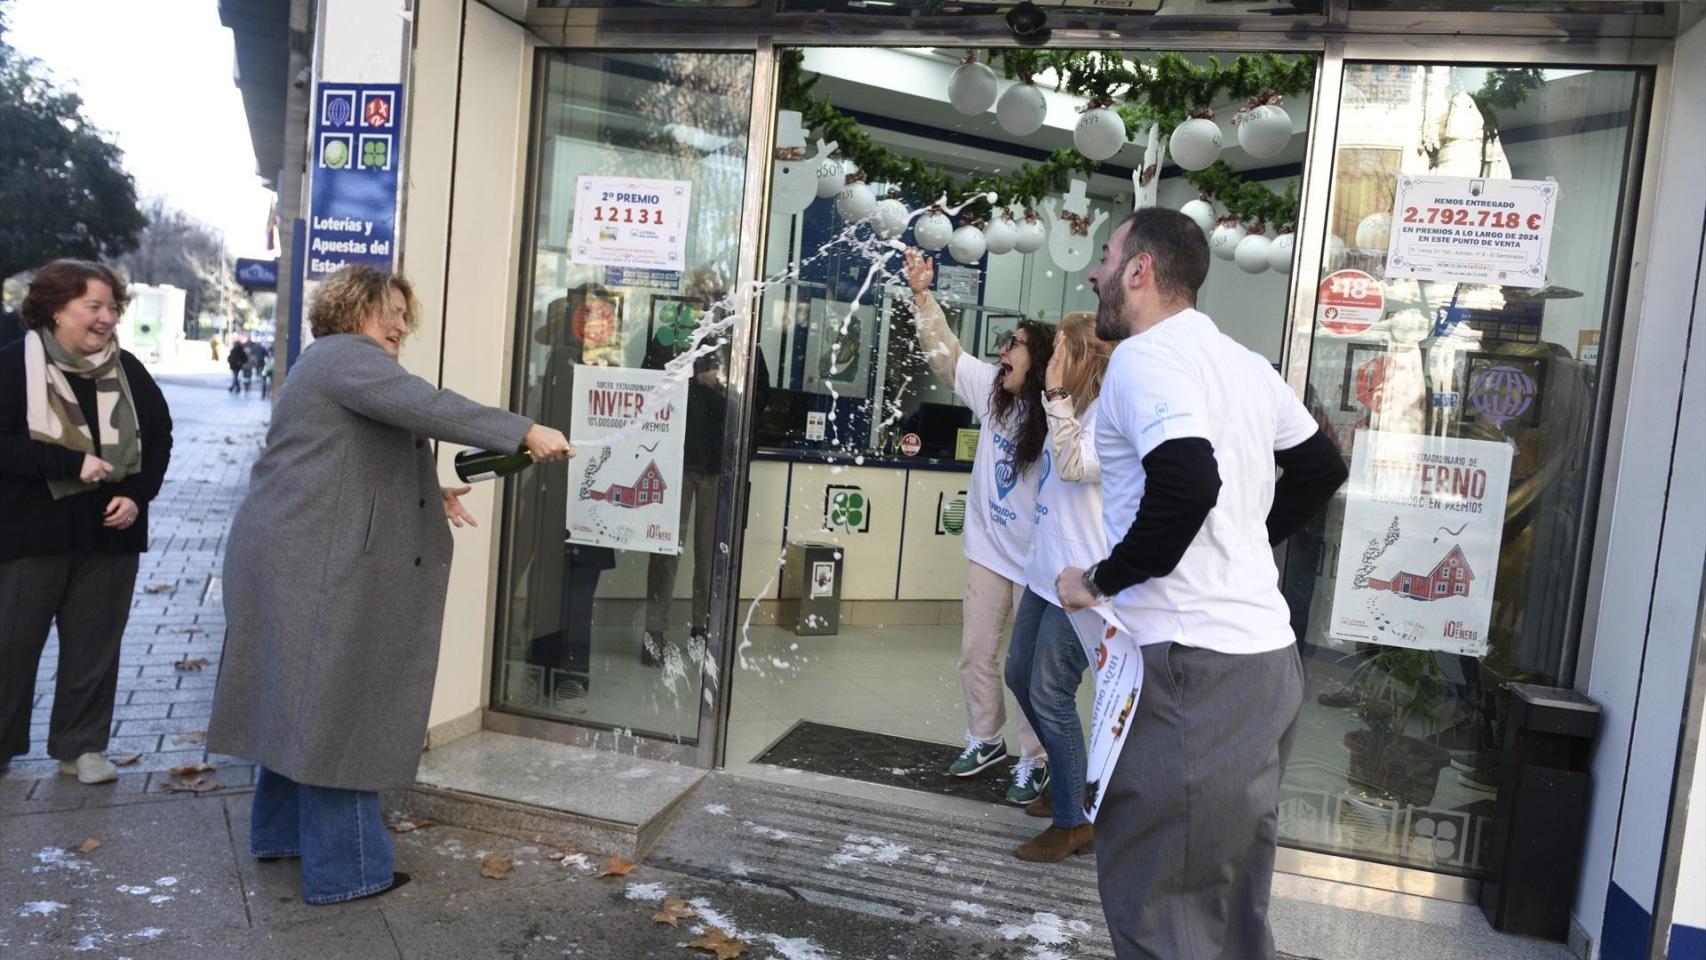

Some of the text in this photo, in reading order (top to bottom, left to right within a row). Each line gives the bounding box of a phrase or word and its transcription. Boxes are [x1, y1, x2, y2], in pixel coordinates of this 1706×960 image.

[617, 193, 660, 205] PREMIO
[1434, 197, 1515, 208] HEMOS ENTREGADO
[1403, 206, 1542, 230] 2.792.718 €
[313, 216, 374, 235] Loterías y
[1402, 226, 1414, 234] EN
[1415, 227, 1453, 236] PREMIOS
[1475, 231, 1503, 239] LARGO
[1518, 233, 1539, 241] 2024
[312, 237, 389, 256] Apuestas del
[1418, 235, 1521, 248] EN ESTE PUNTO DE VENTA
[311, 258, 351, 273] Estad
[1469, 459, 1478, 467] DE
[1428, 500, 1441, 510] EN
[1445, 502, 1483, 514] PREMIOS
[646, 523, 656, 540] 10
[655, 531, 673, 542] ENERO
[1443, 620, 1455, 638] 10
[1455, 628, 1478, 641] ENERO
